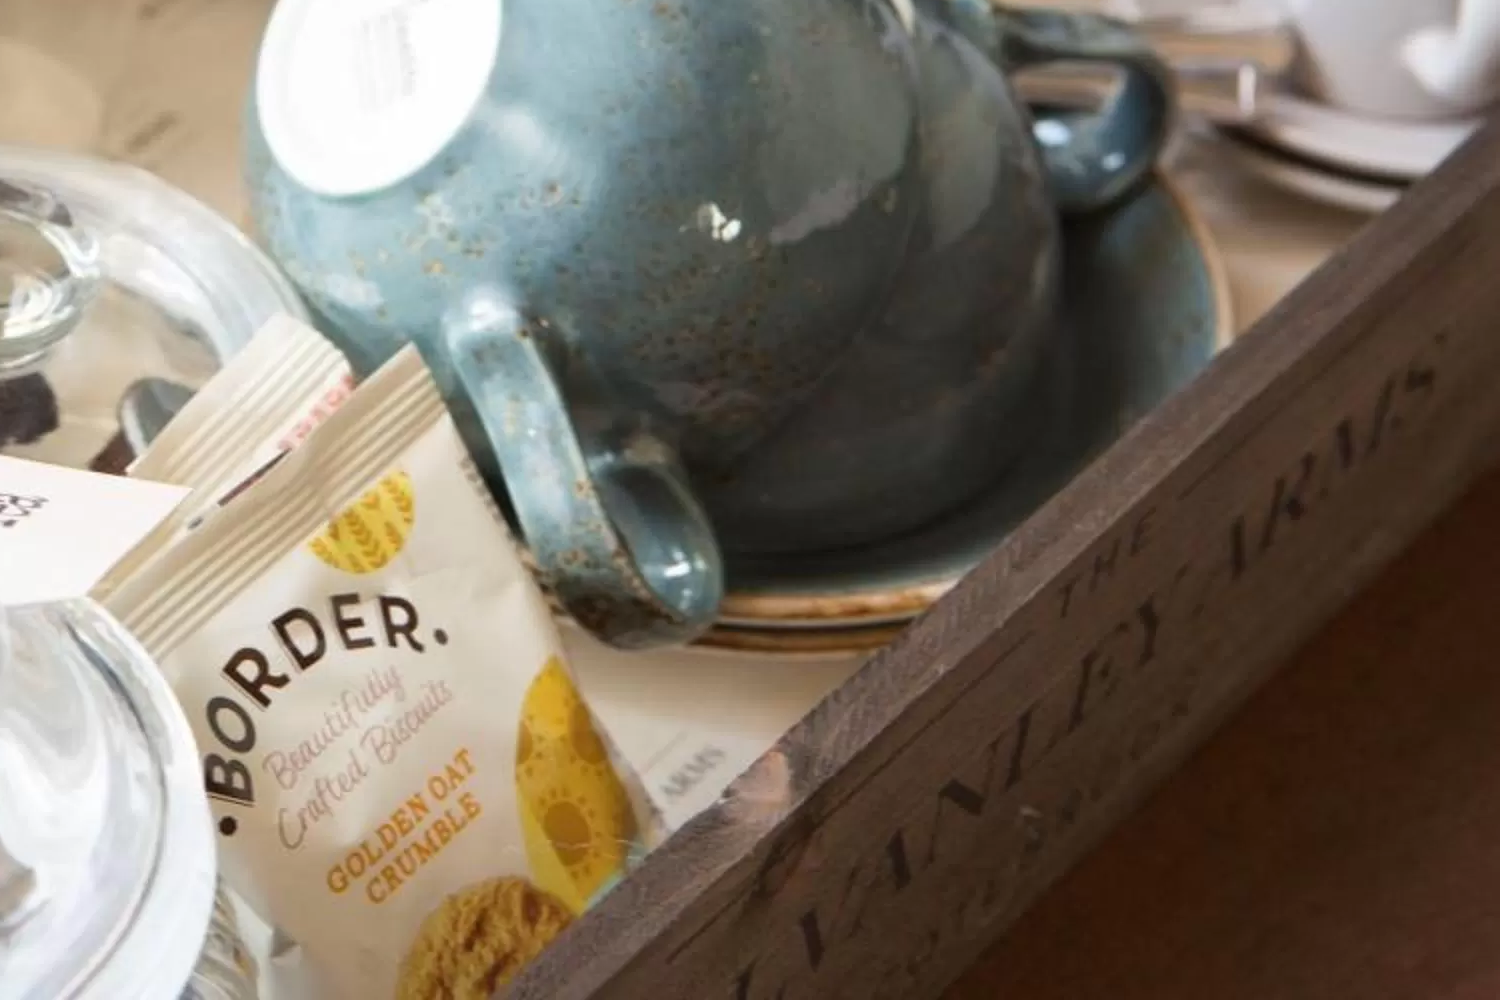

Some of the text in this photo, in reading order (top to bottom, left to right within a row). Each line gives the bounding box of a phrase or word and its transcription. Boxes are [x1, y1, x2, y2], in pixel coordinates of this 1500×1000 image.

[1052, 505, 1158, 619] THE
[262, 663, 407, 790] Beautifully
[276, 678, 453, 850] Crafted Biscuits
[326, 747, 477, 894] GOLDEN OAT
[365, 790, 484, 904] CRUMBLE
